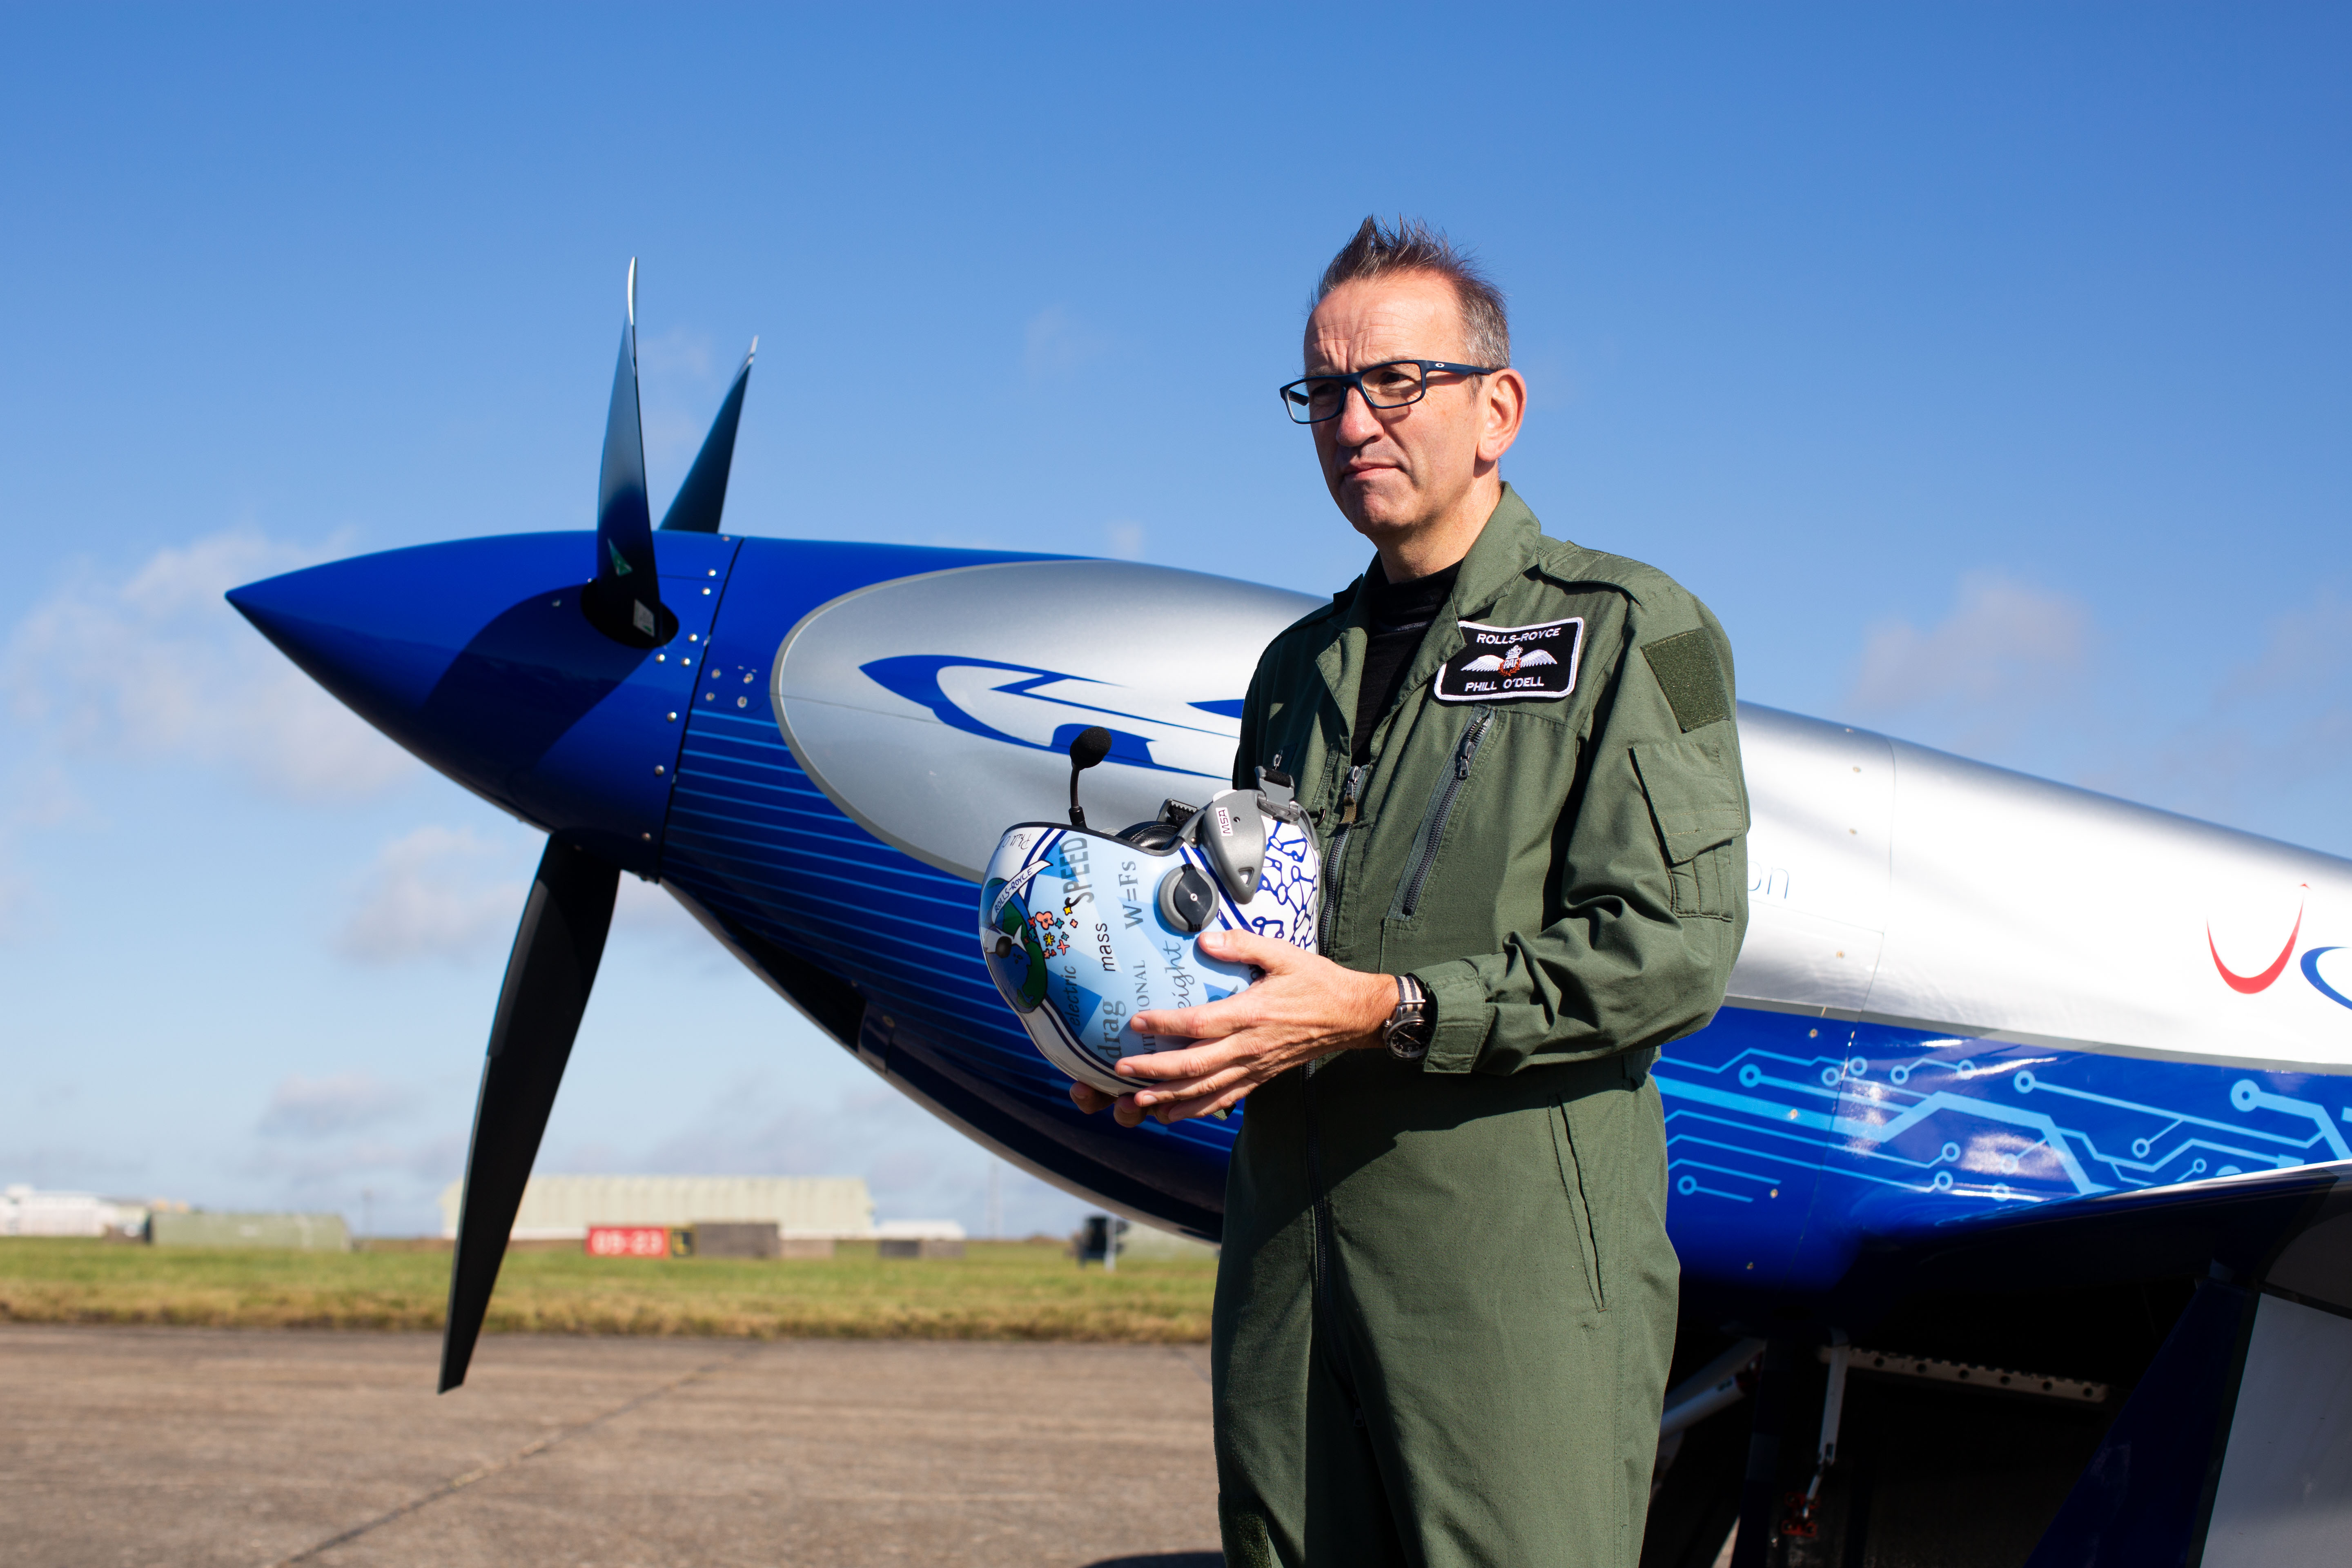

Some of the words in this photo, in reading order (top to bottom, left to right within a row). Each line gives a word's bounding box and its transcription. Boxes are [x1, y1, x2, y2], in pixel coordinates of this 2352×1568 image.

[1476, 628, 1561, 644] ROLLS-ROYCE
[1464, 681, 1497, 692] PHILL
[1503, 676, 1545, 689] O'DELL
[1503, 659, 1519, 669] RAF
[1218, 809, 1231, 833] MSA
[994, 867, 1033, 913] ROLLS-ROYCE
[1059, 837, 1095, 907] SPEED
[1096, 923, 1116, 971] mass
[1060, 966, 1080, 1026] electric
[1163, 940, 1195, 1009] eight
[1097, 999, 1126, 1059] drag
